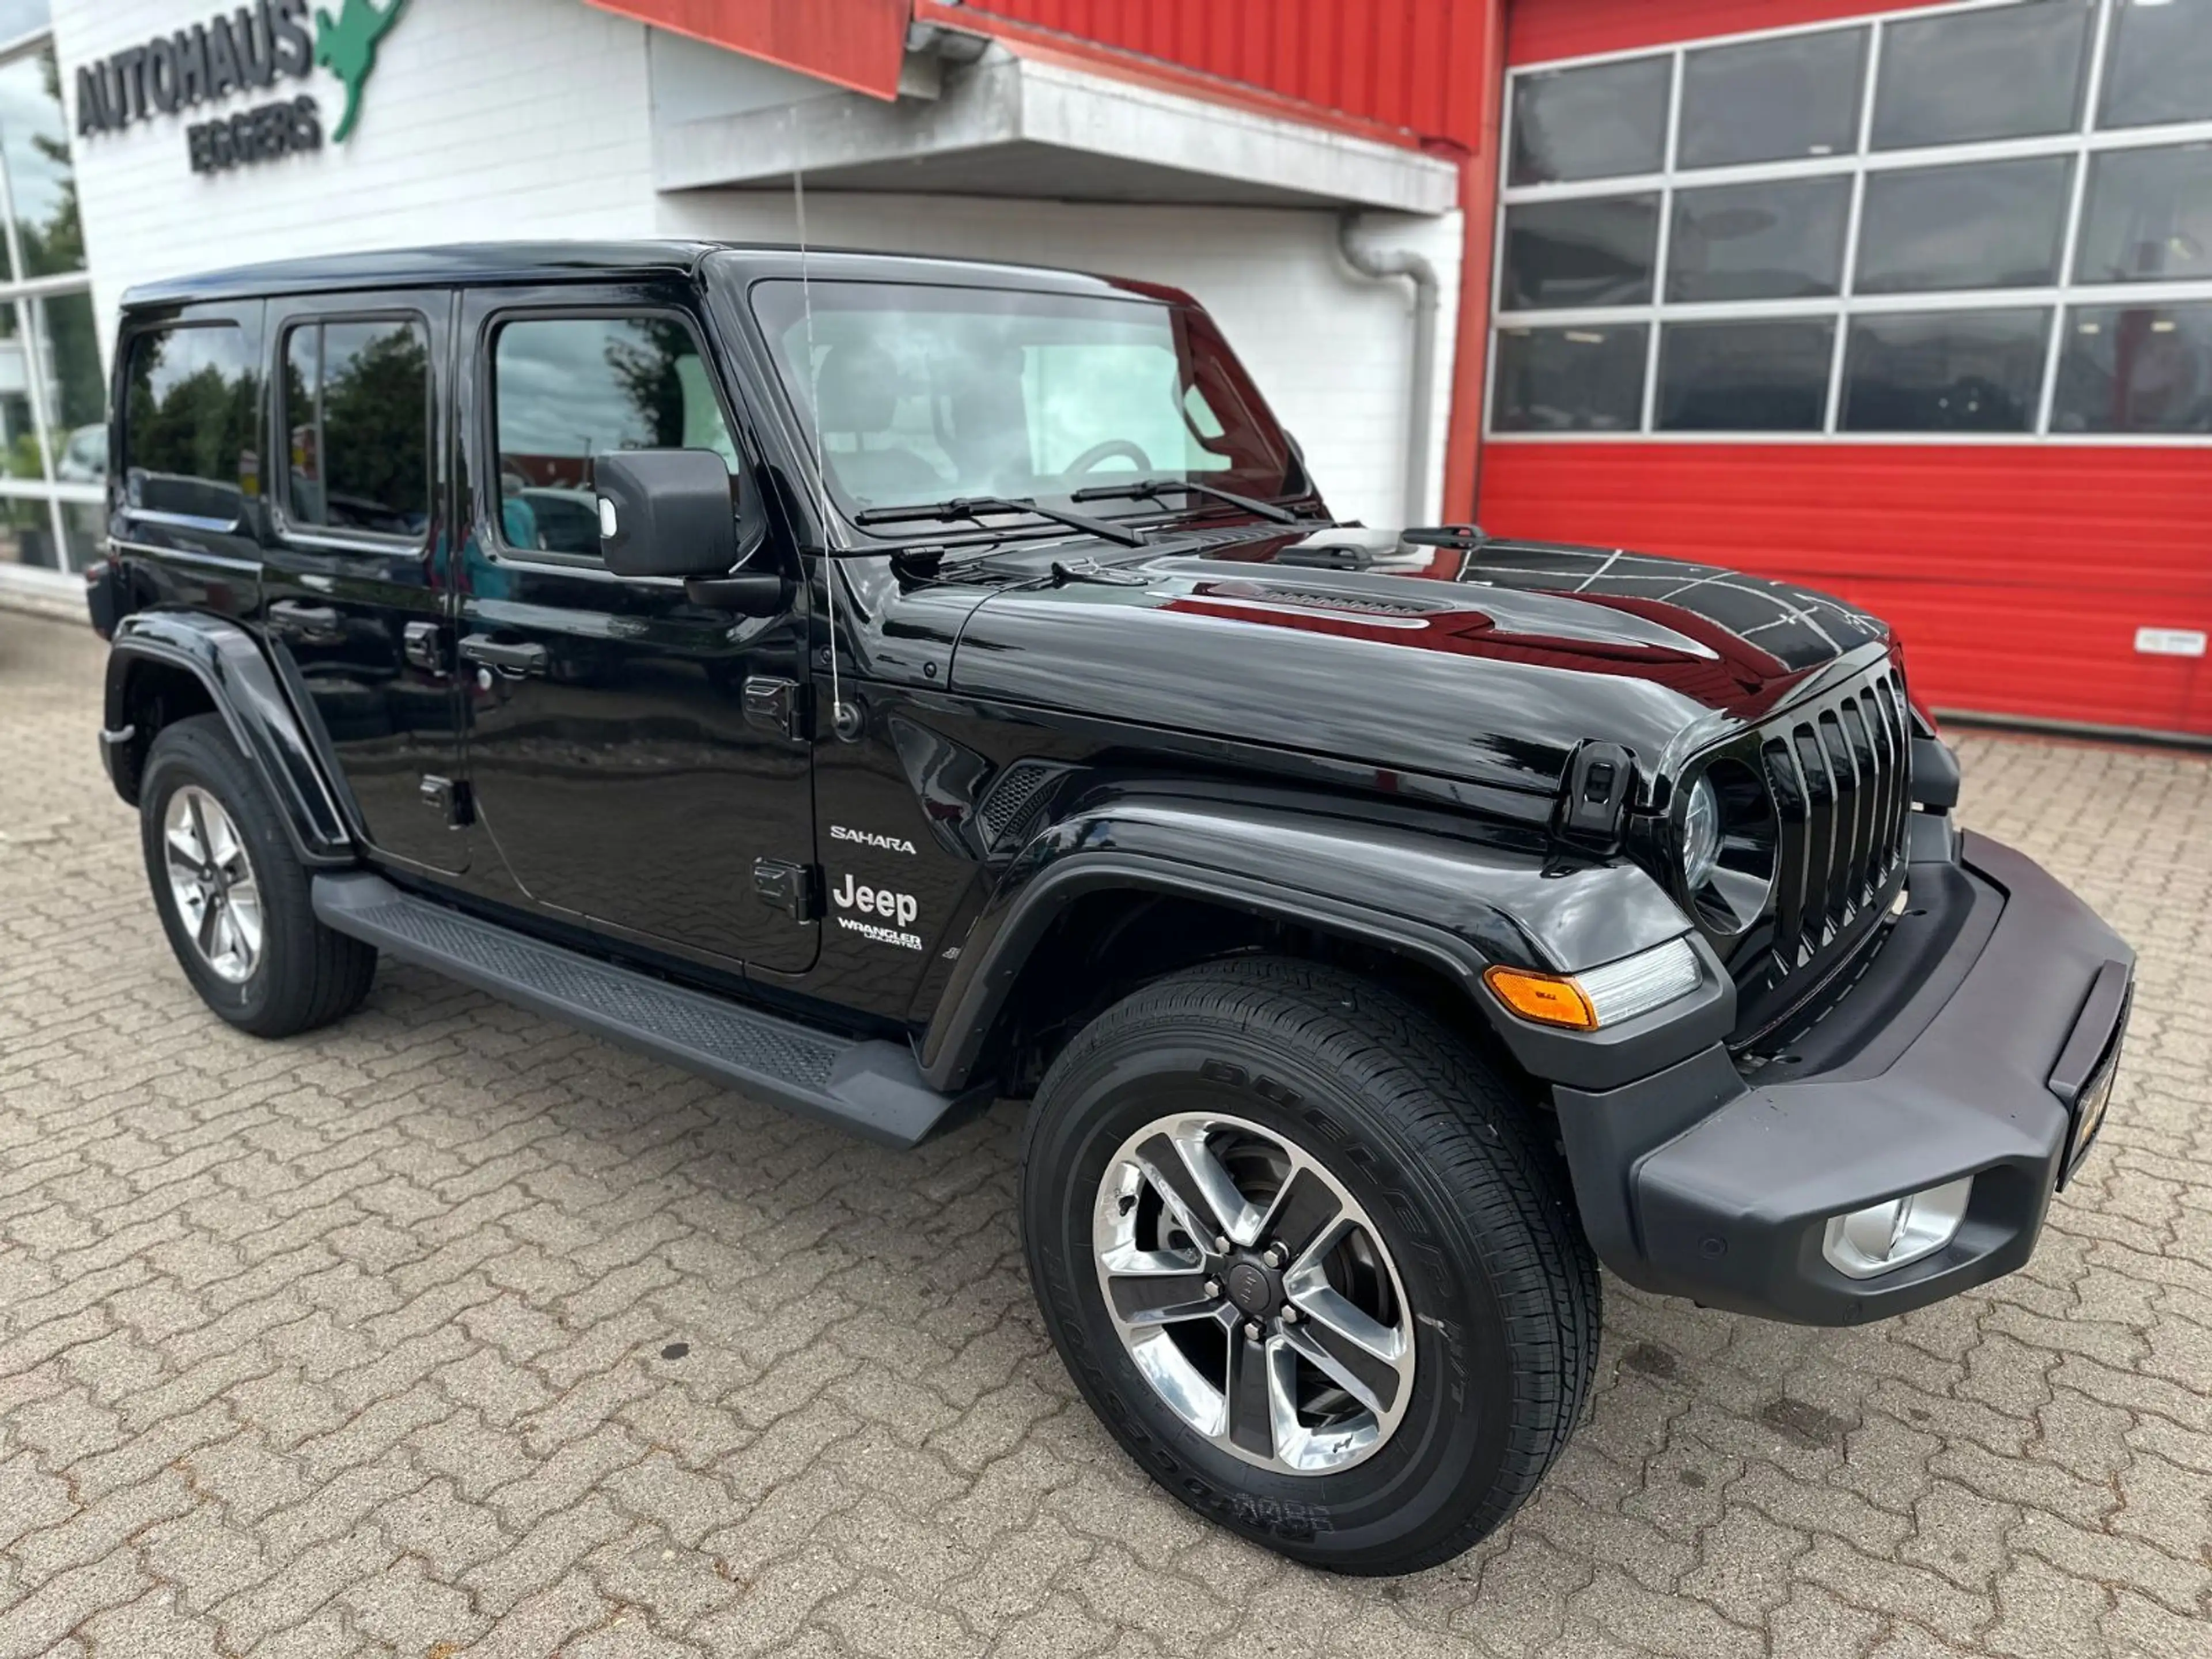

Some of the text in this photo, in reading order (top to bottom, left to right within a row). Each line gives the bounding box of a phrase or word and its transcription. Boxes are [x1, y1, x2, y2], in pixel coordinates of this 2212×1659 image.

[77, 0, 314, 137] AUTOHAUS
[187, 94, 322, 172] EGGERS
[830, 825, 916, 855] SAHARA
[833, 874, 917, 927] Jeep
[837, 916, 921, 945] WRANGLER
[1199, 1058, 1453, 1298] DUELER
